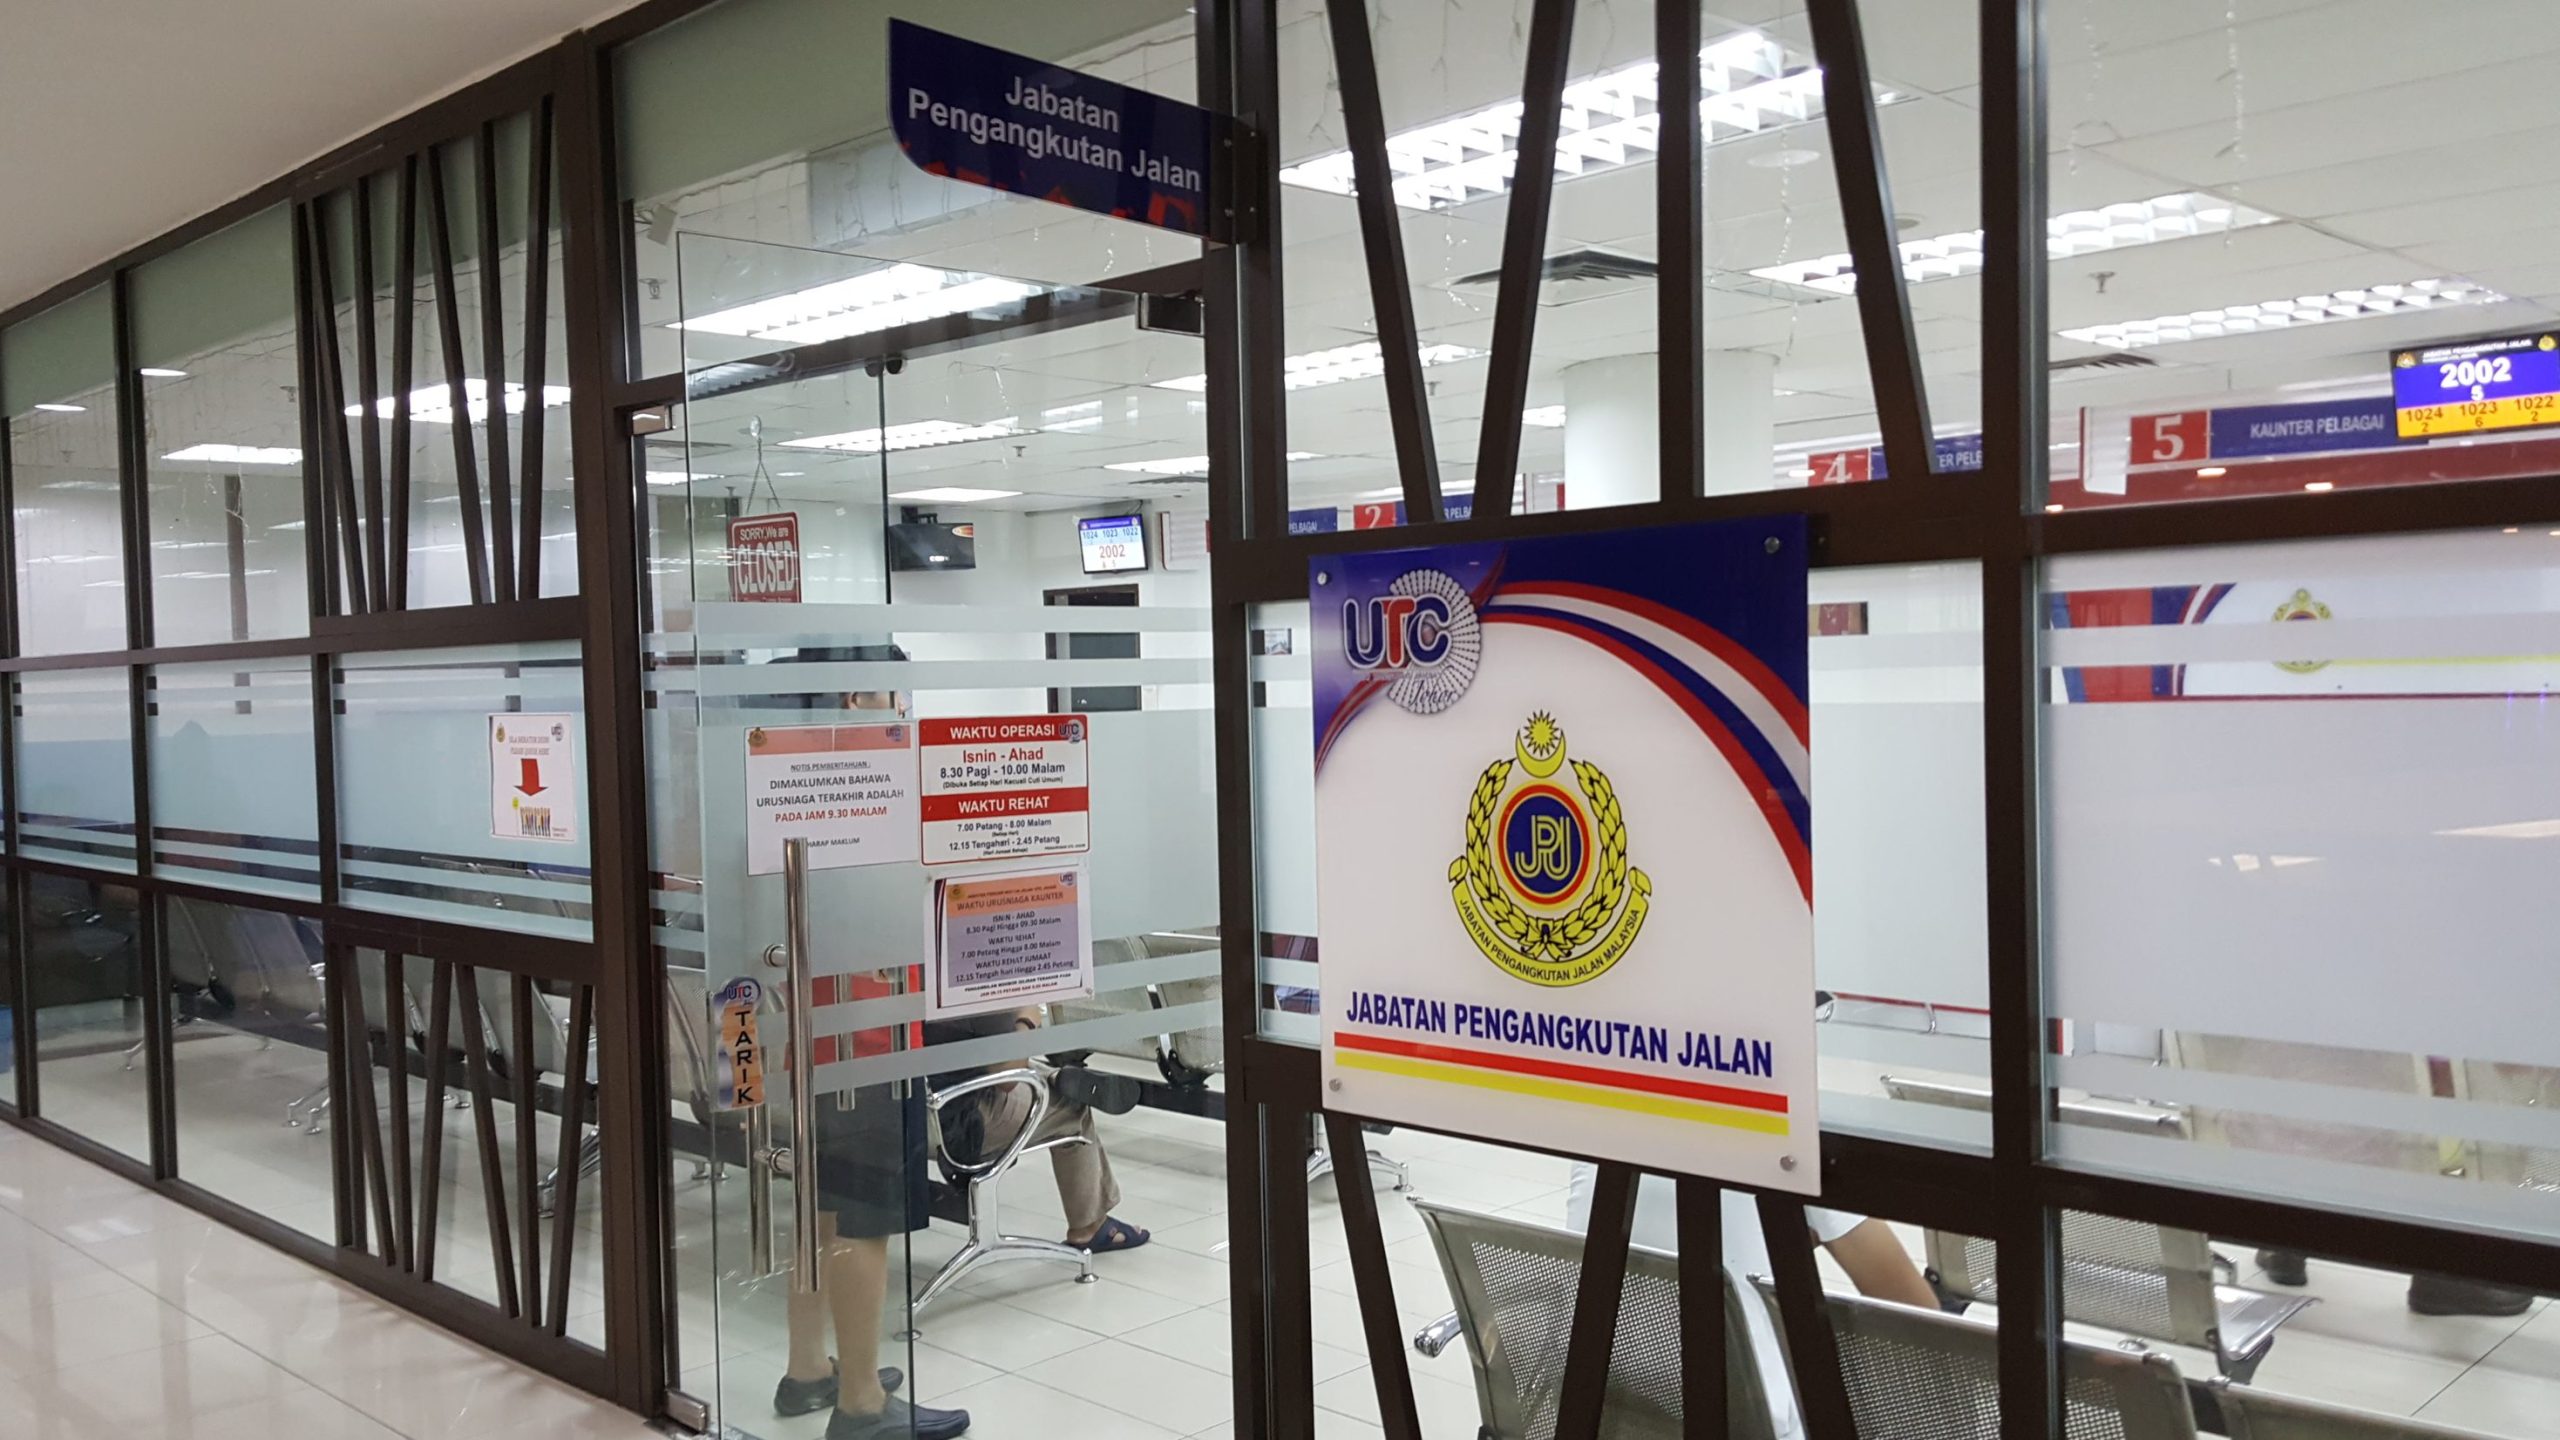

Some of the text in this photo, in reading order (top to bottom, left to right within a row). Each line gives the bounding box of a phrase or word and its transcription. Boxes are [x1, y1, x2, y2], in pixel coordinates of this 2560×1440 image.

[1005, 77, 1119, 133] Jabatan
[908, 88, 1200, 192] Pengangkutan Jalan
[2439, 357, 2512, 388] 2002
[2471, 385, 2485, 401] 5
[2406, 395, 2554, 422] 1024 1023 1022
[2250, 414, 2385, 438] KAUNTER PELBAGAI
[2422, 411, 2539, 432] 2 6 2
[2152, 414, 2184, 460] 5
[1823, 453, 1852, 483] 4
[1365, 505, 1382, 528] 2
[1099, 544, 1126, 559] 2002
[738, 540, 795, 595] CLOSED
[1343, 592, 1452, 669] UTC
[950, 723, 1080, 740] WAKTU OPERASI UTC
[963, 750, 996, 763] Isnin
[1009, 747, 1044, 761] Ahad
[790, 763, 811, 773] NOTIS
[940, 767, 963, 779] 8.30
[967, 766, 991, 779] Pagi
[1001, 764, 1028, 776] 10.00
[1032, 763, 1065, 774] Malam
[770, 774, 891, 790] DIMAKLUMKAN BAHAWA
[943, 781, 968, 790] (Dibuka
[969, 779, 988, 788] Setiap
[990, 778, 1002, 786] Hari
[1042, 775, 1064, 784] Umum)
[756, 789, 905, 808] URUSNIAGA TERAKHIR ADALAH
[958, 796, 1050, 813] WAKTU REHAT
[775, 806, 888, 823] PADA JAM 9.30 MALAM
[957, 823, 974, 832] 7.00
[976, 821, 1003, 832] Petang
[1009, 820, 1025, 829] 8.00
[1027, 818, 1052, 827] Malam
[830, 837, 860, 847] MAKLUM
[949, 842, 970, 851] 12.15
[971, 839, 1010, 852] Tengahari
[1017, 836, 1033, 845] 2.45
[1034, 835, 1061, 846] Petang
[957, 901, 984, 911] WAKTU
[987, 896, 1029, 909] URUSNIAGA
[1031, 891, 1063, 903] KAUNTER
[992, 913, 1011, 923] ISNIN
[1016, 910, 1036, 920] AHAD
[966, 917, 1062, 935] 8.30 Pagi Hingga 09.30 Malam
[988, 932, 1036, 945] WAKTU REHAT
[1459, 898, 1641, 982] JABATAN PENGANGKUTAN JALAN MALAYSIA
[961, 940, 1062, 959] 7.00 Petang Hingga 8.00 Malam
[975, 952, 1052, 969] WAKTU REHAT JUMAAT
[956, 973, 975, 982] 12.15
[975, 969, 999, 980] Tengah
[1014, 964, 1036, 975] Hingga
[1036, 961, 1052, 971] 2.45
[1052, 960, 1074, 969] Petang
[727, 985, 752, 1000] UTC
[1347, 991, 1773, 1078] JABATAN PENGANGKUTAN JALAN
[734, 1010, 755, 1104] TARIK
